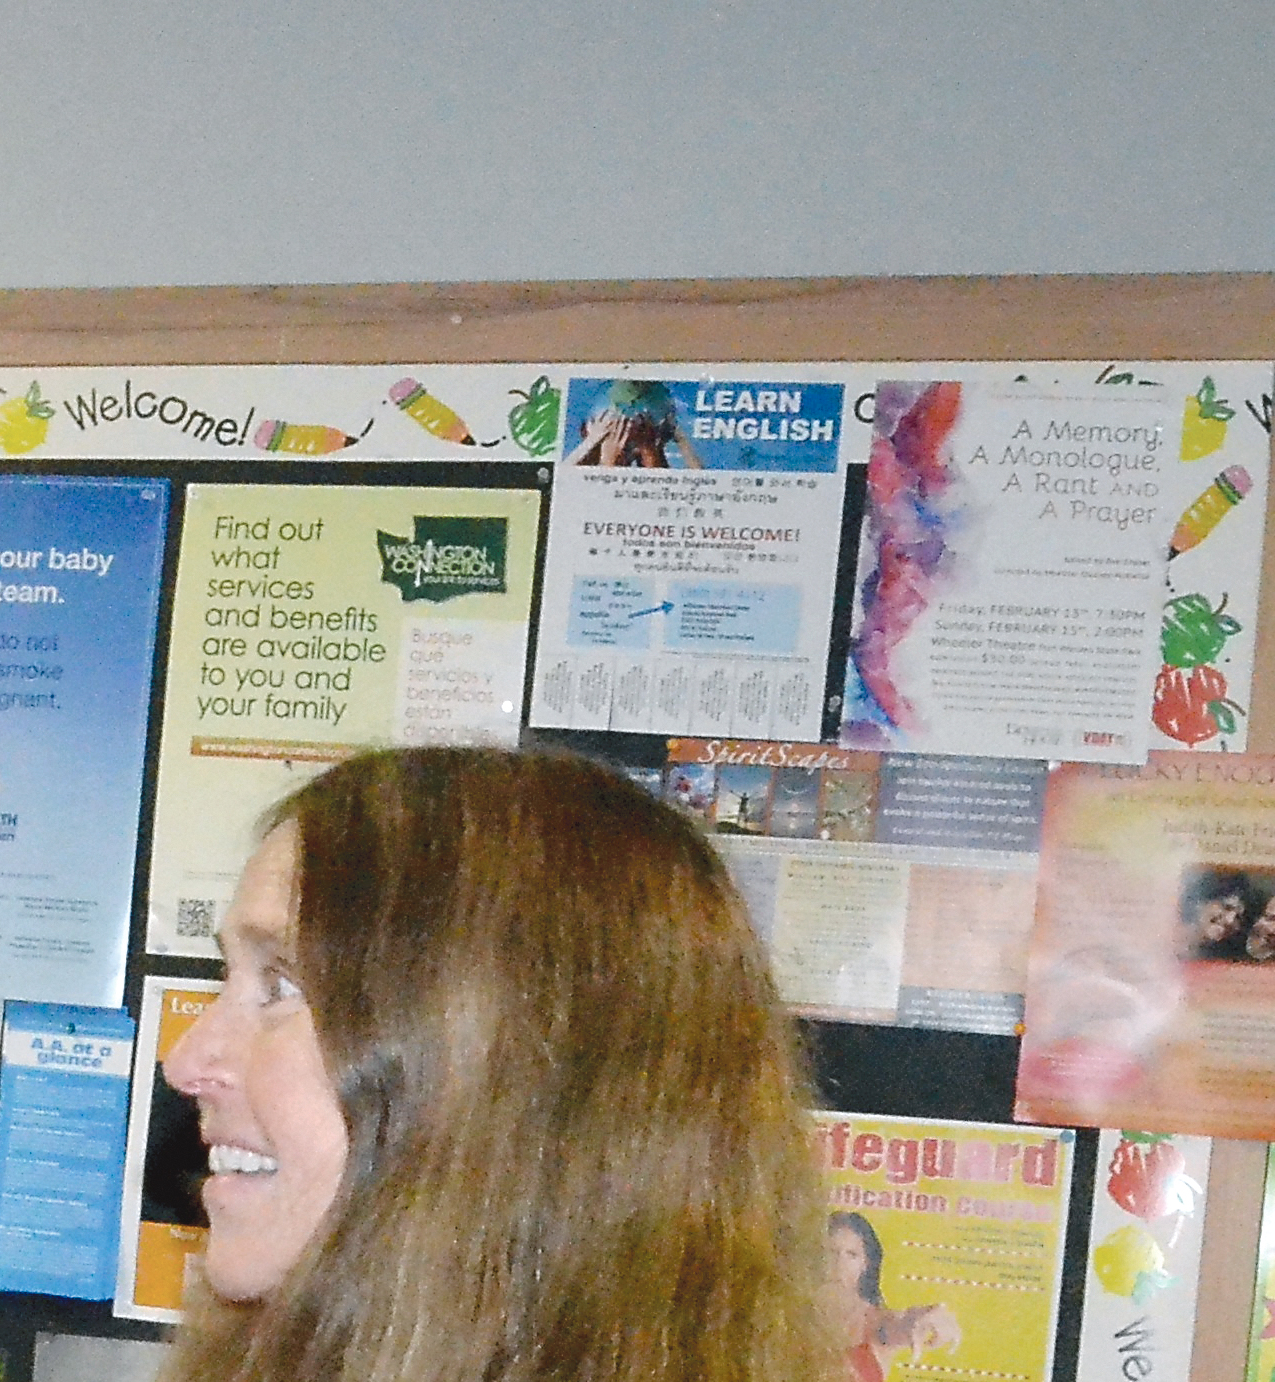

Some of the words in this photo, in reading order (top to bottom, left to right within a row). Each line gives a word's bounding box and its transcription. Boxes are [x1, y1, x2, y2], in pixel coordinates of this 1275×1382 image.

[63, 380, 255, 447] Welcome!
[697, 390, 802, 413] LEARN
[693, 418, 833, 442] ENGLISH
[1012, 421, 1033, 438] A
[968, 446, 989, 465] A
[1001, 474, 1023, 493] A
[1035, 473, 1099, 496] Rant
[1109, 483, 1159, 498] AND
[1038, 501, 1057, 519] A
[1070, 501, 1159, 531] Prayer
[215, 516, 269, 541] Find
[279, 517, 324, 541] out
[583, 522, 676, 538] EVERYONE
[681, 526, 696, 538] IS
[702, 526, 801, 542] WELCOME!
[48, 546, 113, 576] baby
[211, 545, 281, 570] what
[384, 541, 487, 563] WASHINGTON
[392, 560, 496, 577] CONNECTION
[206, 576, 315, 600] services
[204, 605, 260, 629] and
[270, 606, 379, 632] benefits
[26, 632, 60, 652] not
[202, 638, 248, 658] are
[257, 635, 387, 664] available
[200, 664, 226, 686] to
[235, 667, 284, 693] you
[294, 666, 352, 691] and
[197, 696, 255, 720] your
[265, 695, 348, 727] family
[37, 1051, 102, 1068] glance
[73, 1042, 94, 1054] at
[100, 1047, 112, 1057] a
